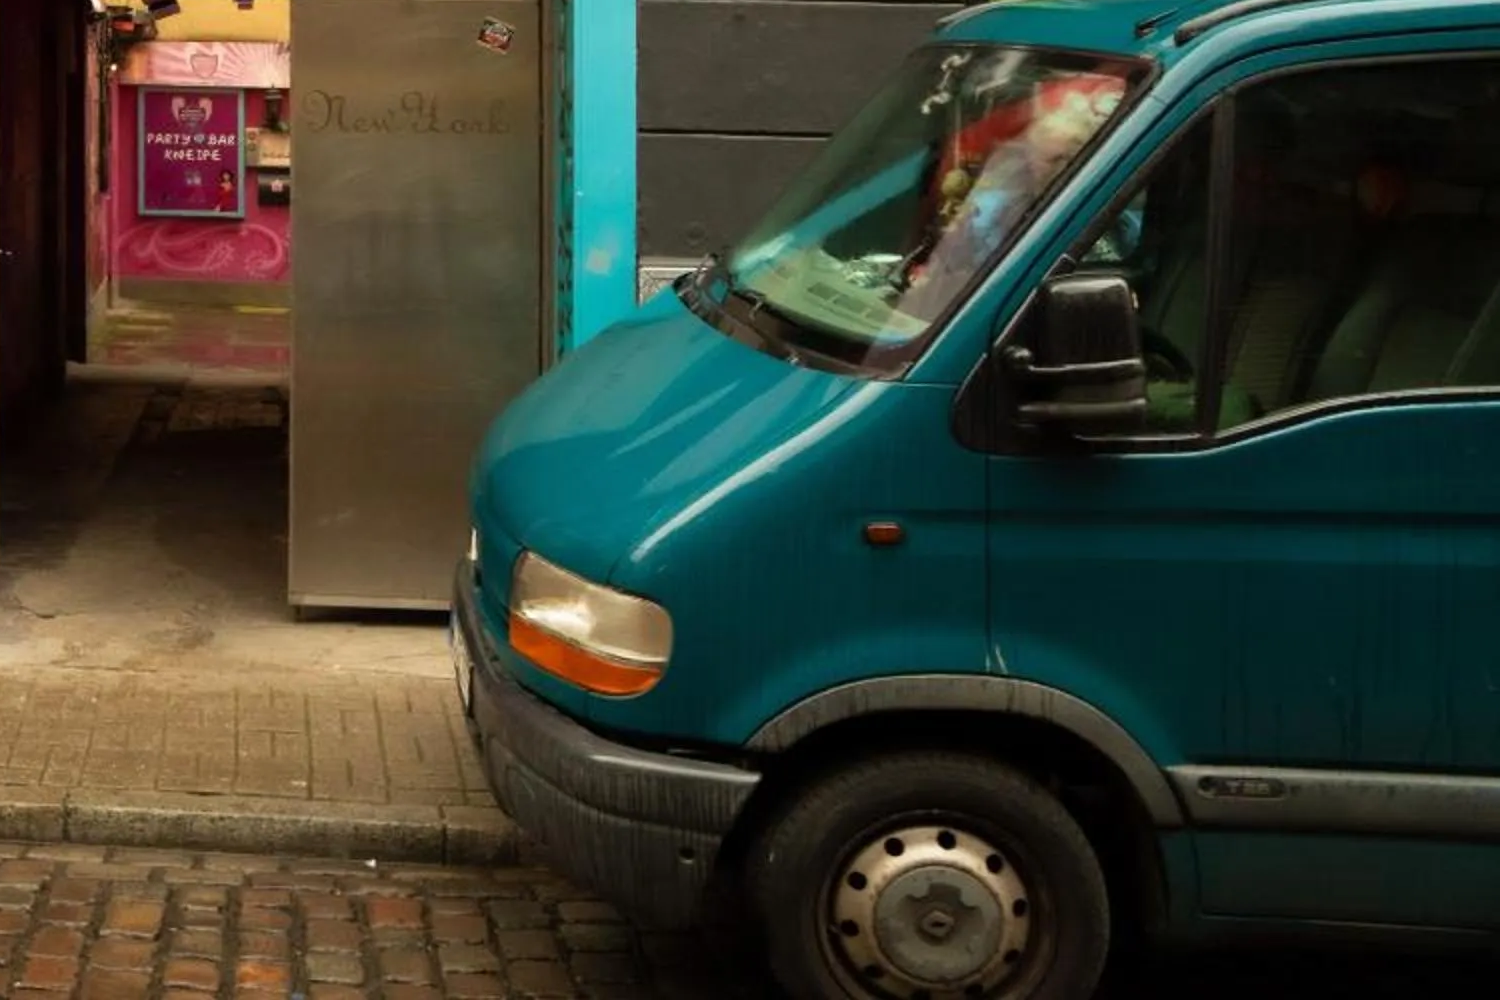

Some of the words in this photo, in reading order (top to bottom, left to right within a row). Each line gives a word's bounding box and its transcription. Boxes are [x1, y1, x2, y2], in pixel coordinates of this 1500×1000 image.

[146, 133, 192, 145] PARTY
[207, 133, 235, 145] BAR
[164, 149, 221, 161] KNEIPE
